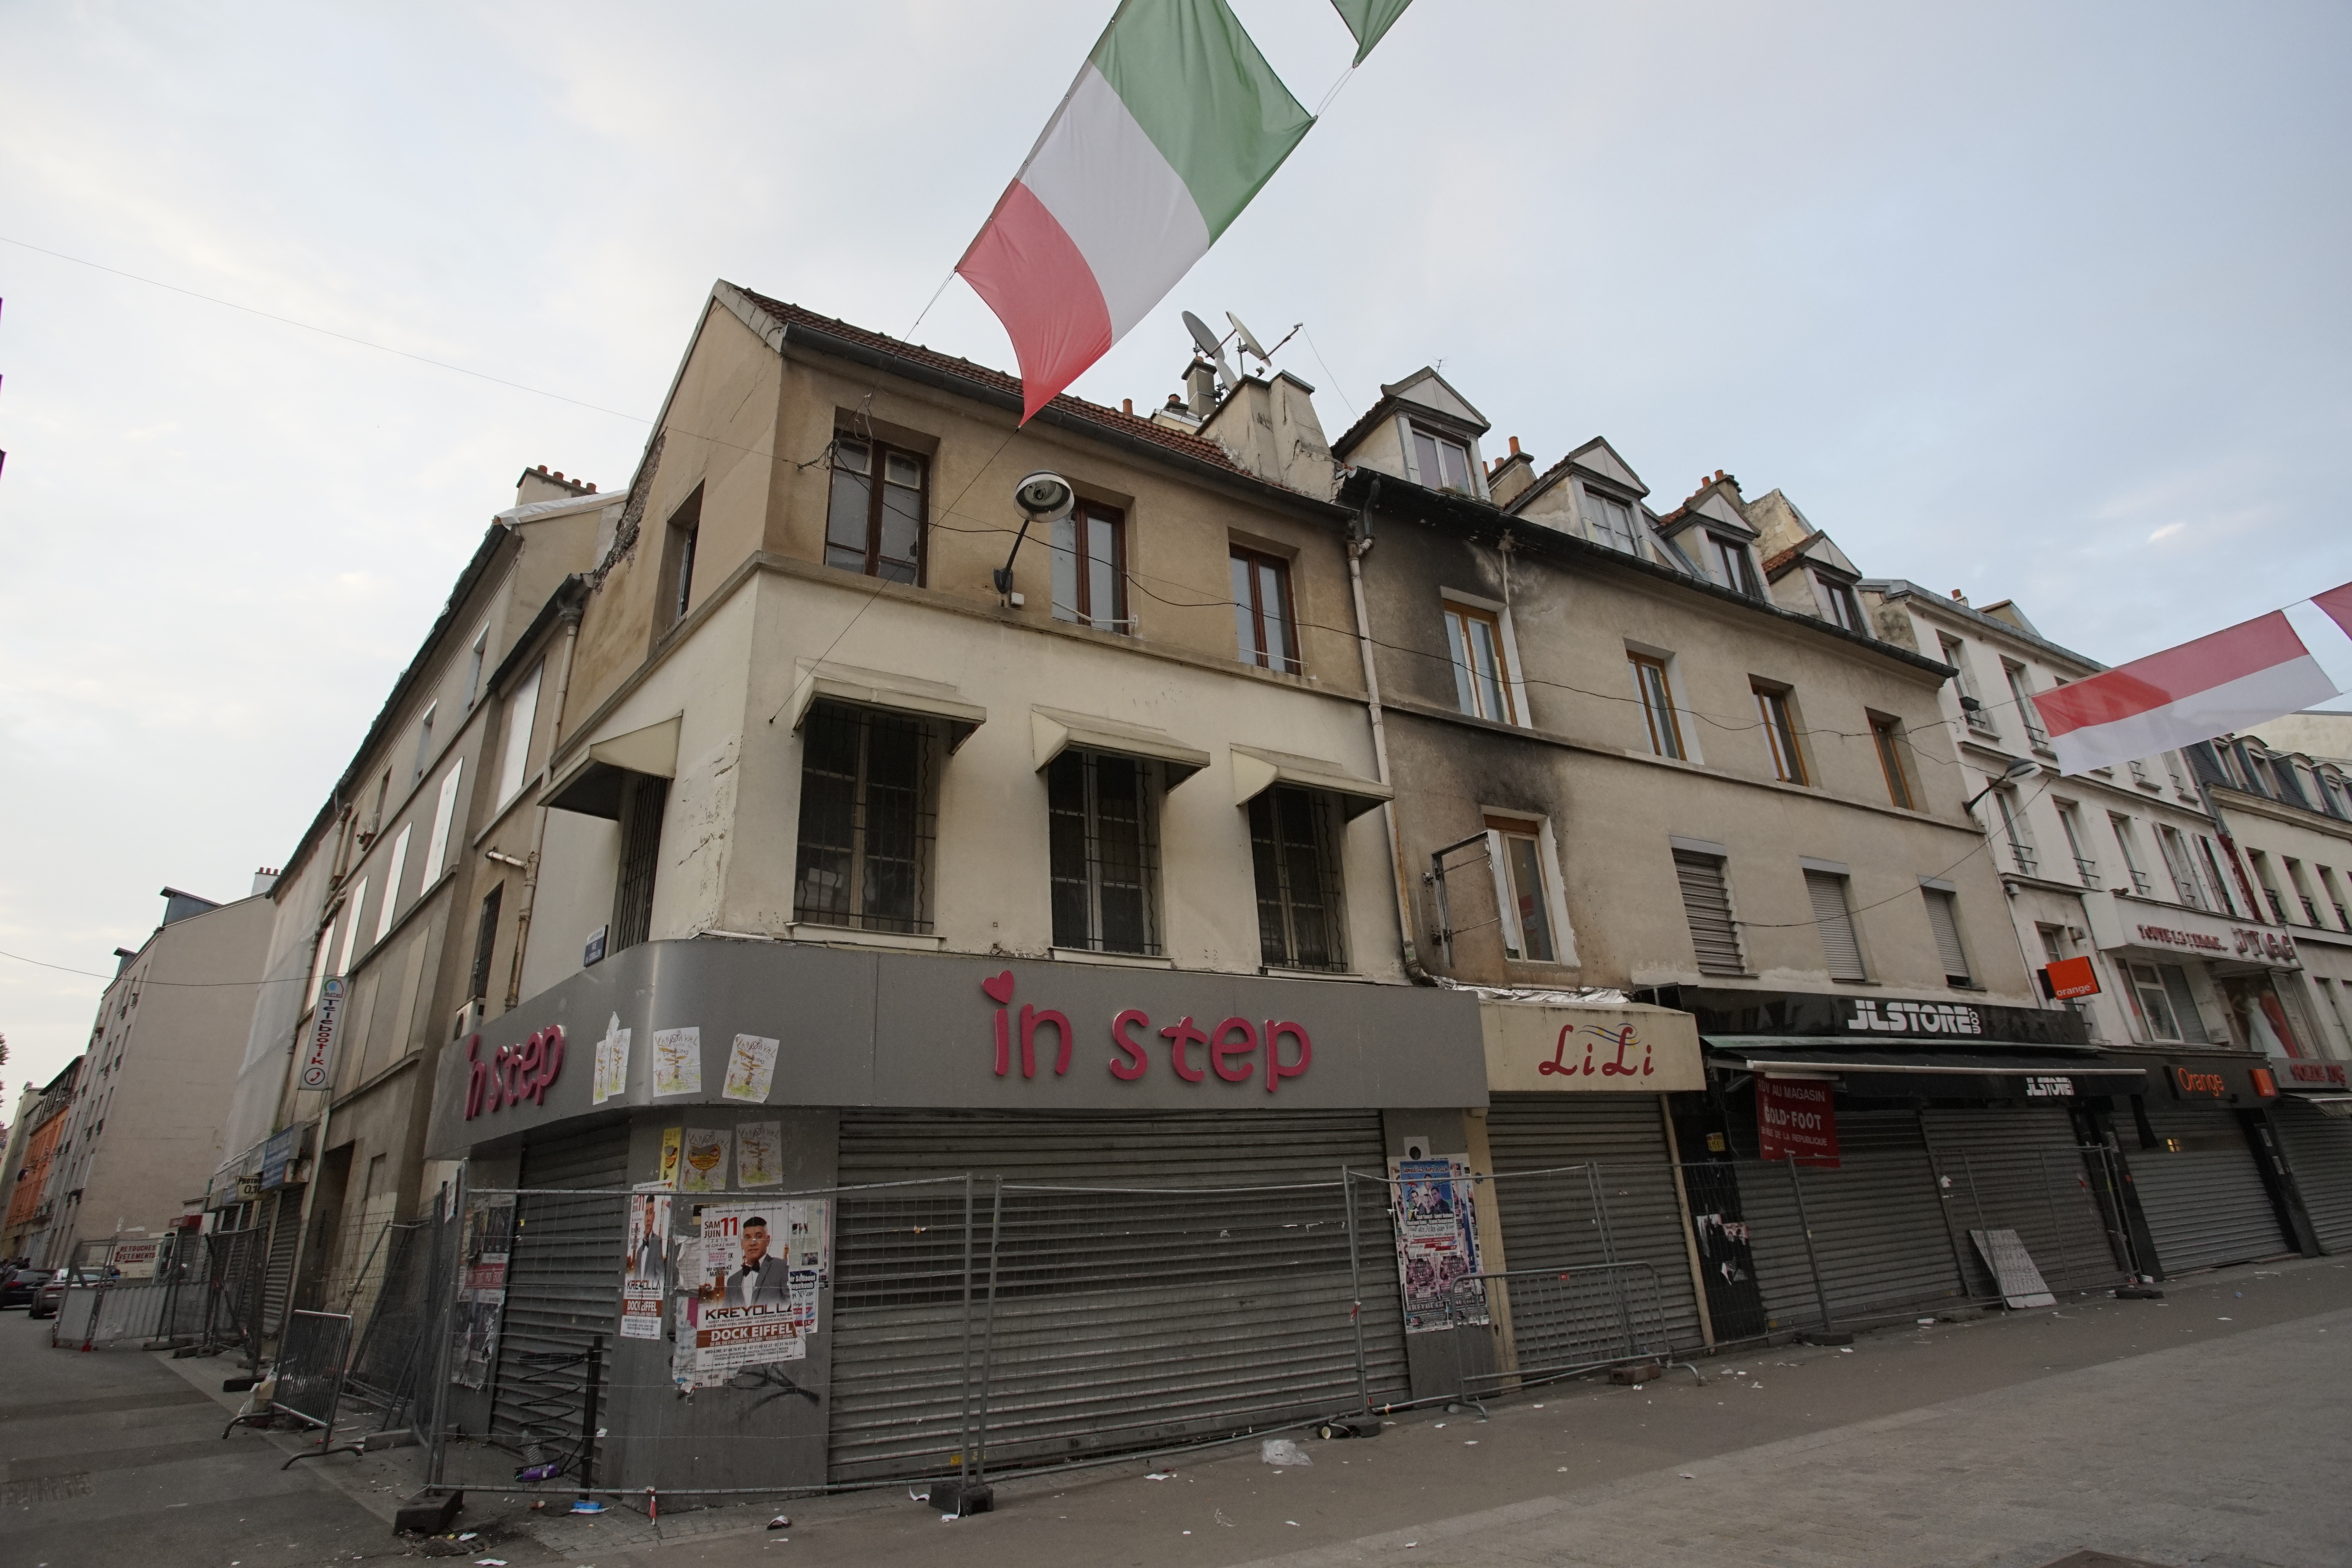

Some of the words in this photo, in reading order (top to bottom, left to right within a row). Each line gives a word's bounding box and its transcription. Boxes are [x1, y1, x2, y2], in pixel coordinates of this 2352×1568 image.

[2056, 985, 2091, 996] orange
[982, 971, 1073, 1078] in
[1110, 1009, 1312, 1092] step
[1539, 1024, 1654, 1076] LiLi
[464, 1033, 486, 1121] in
[487, 1025, 564, 1112] step
[2178, 1068, 2225, 1096] Orange
[1772, 1084, 1782, 1097] AU
[1784, 1086, 1826, 1102] MAGASIN
[704, 1220, 720, 1229] SAM
[720, 1216, 738, 1236] 11
[704, 1230, 720, 1238] JUIN
[627, 1301, 640, 1311] DOCK
[711, 1327, 748, 1342] DOCK
[751, 1323, 793, 1338] EIFFEL
